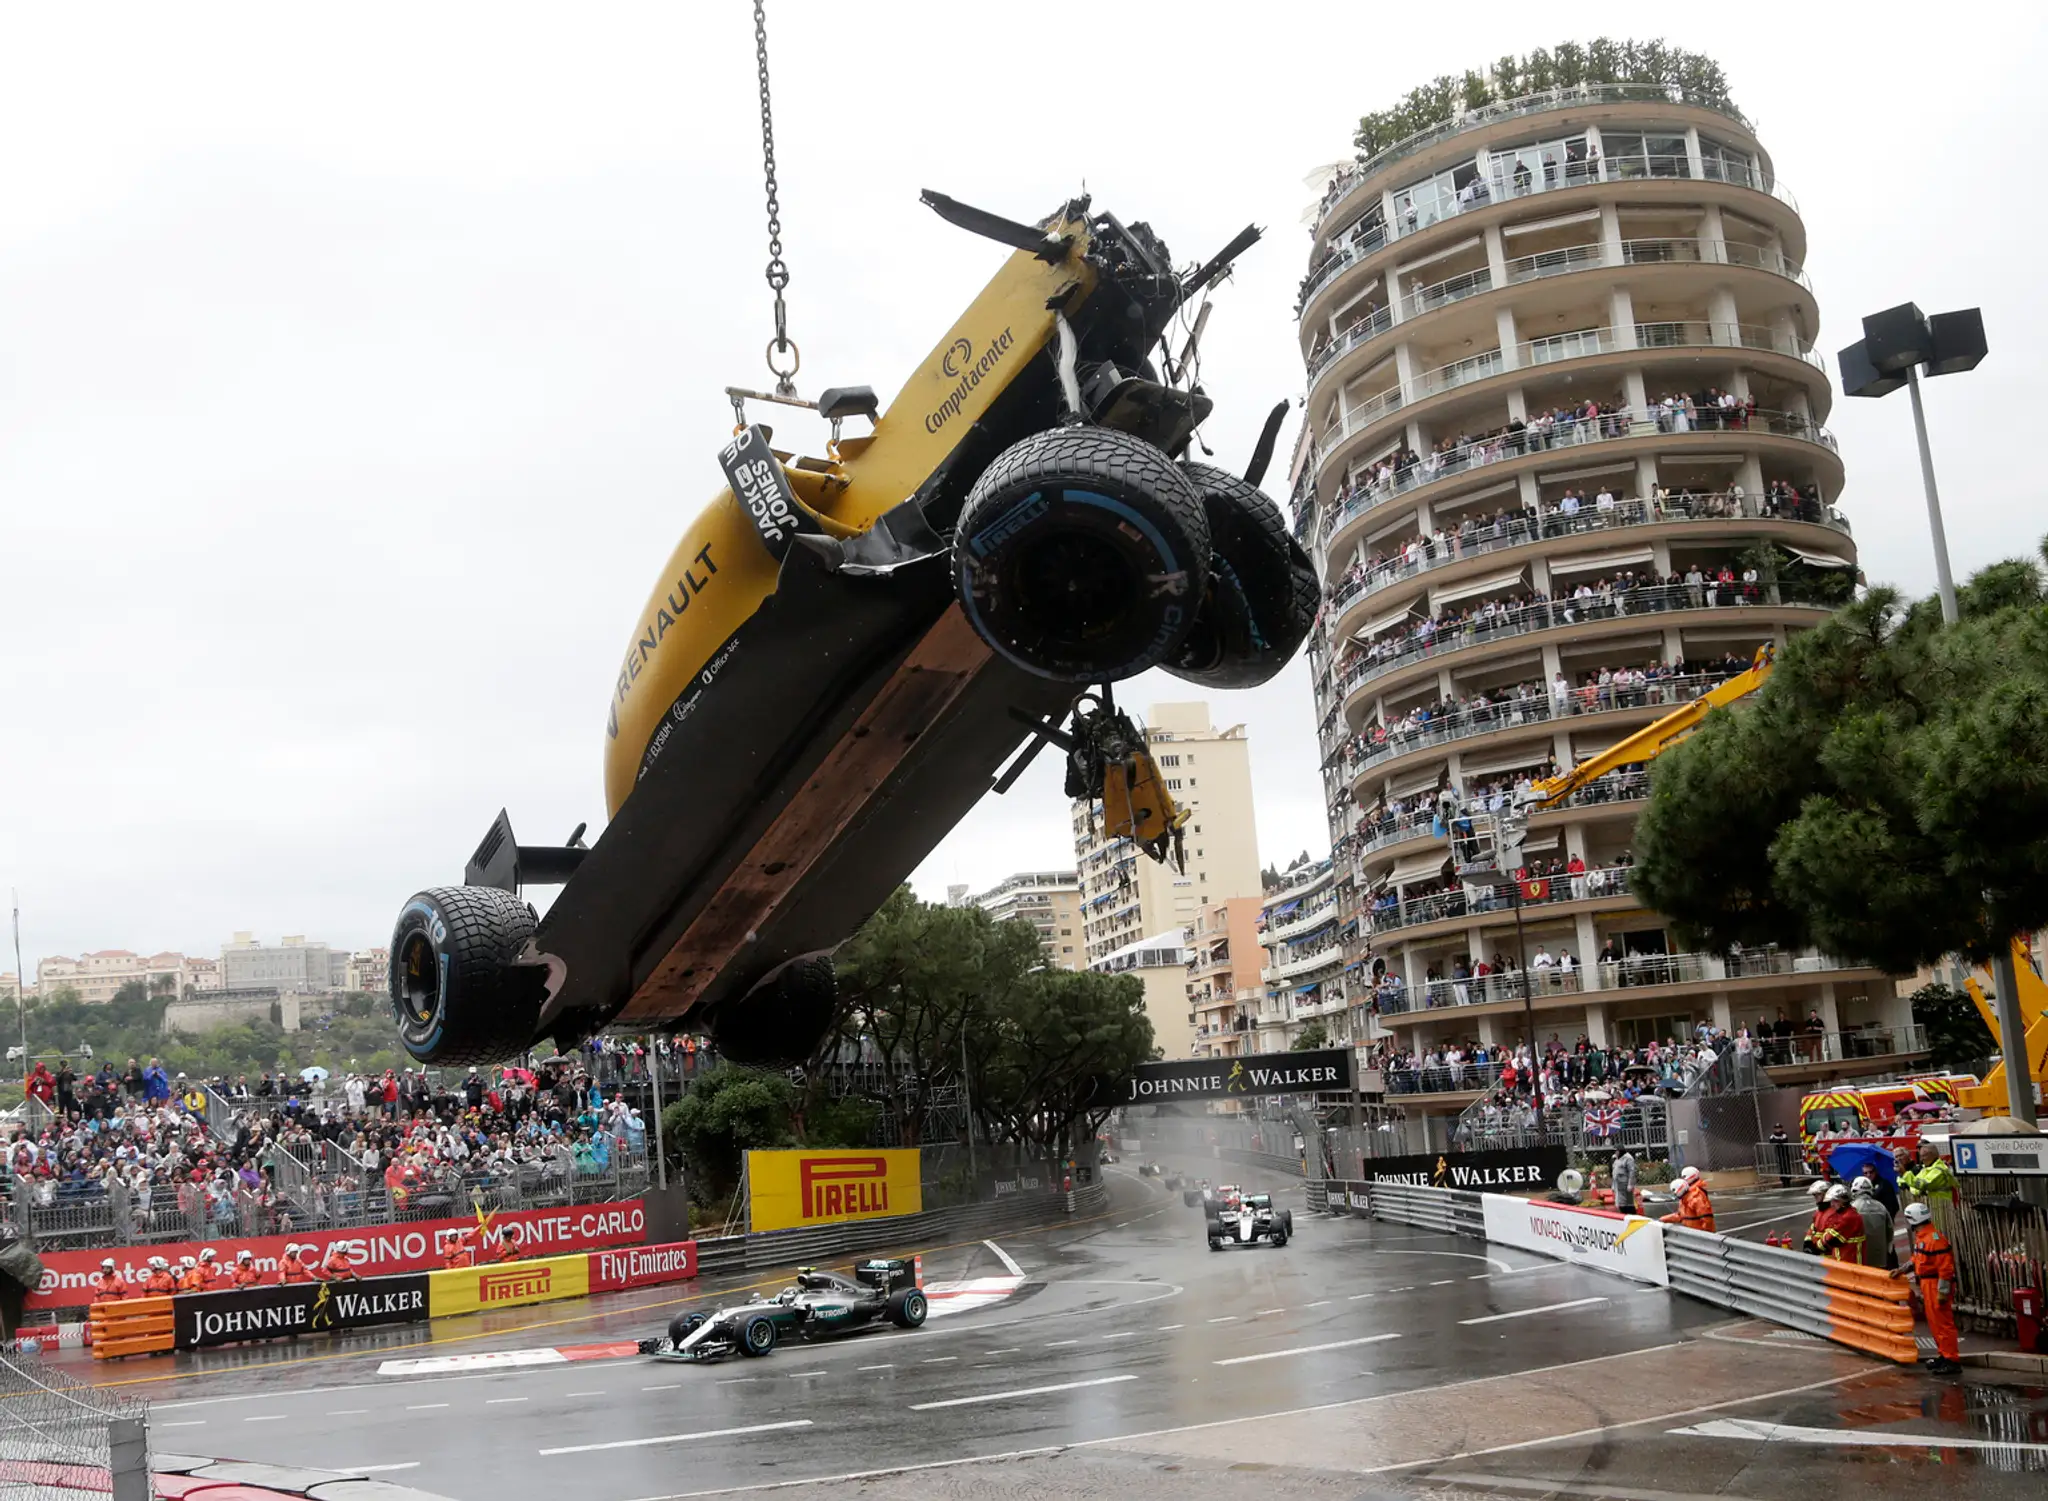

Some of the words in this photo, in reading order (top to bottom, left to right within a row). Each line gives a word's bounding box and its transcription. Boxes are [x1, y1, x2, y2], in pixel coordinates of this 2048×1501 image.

[925, 326, 1015, 434] Computacenter
[743, 483, 783, 542] JACK
[752, 459, 799, 528] JONES
[970, 491, 1050, 559] PIRELLI
[616, 541, 718, 703] RENAULT
[650, 721, 674, 758] ELYSIUM
[1128, 1075, 1222, 1101] JOHNNIE
[1248, 1066, 1338, 1087] WALKER
[1962, 1148, 1971, 1166] P
[1984, 1140, 2010, 1151] Sainte
[2012, 1139, 2044, 1151] Dévote
[800, 1156, 888, 1218] PIRELLI
[1451, 1165, 1543, 1186] WALKER
[294, 1231, 427, 1271] CASINO
[482, 1208, 644, 1250] MONTE-CARLO
[1529, 1216, 1562, 1240] MONACO
[479, 1267, 551, 1302] PIRELLI
[601, 1251, 628, 1284] Fly
[629, 1246, 688, 1277] Emirates
[190, 1304, 306, 1344] JOHNNIE
[335, 1290, 423, 1319] WALKER
